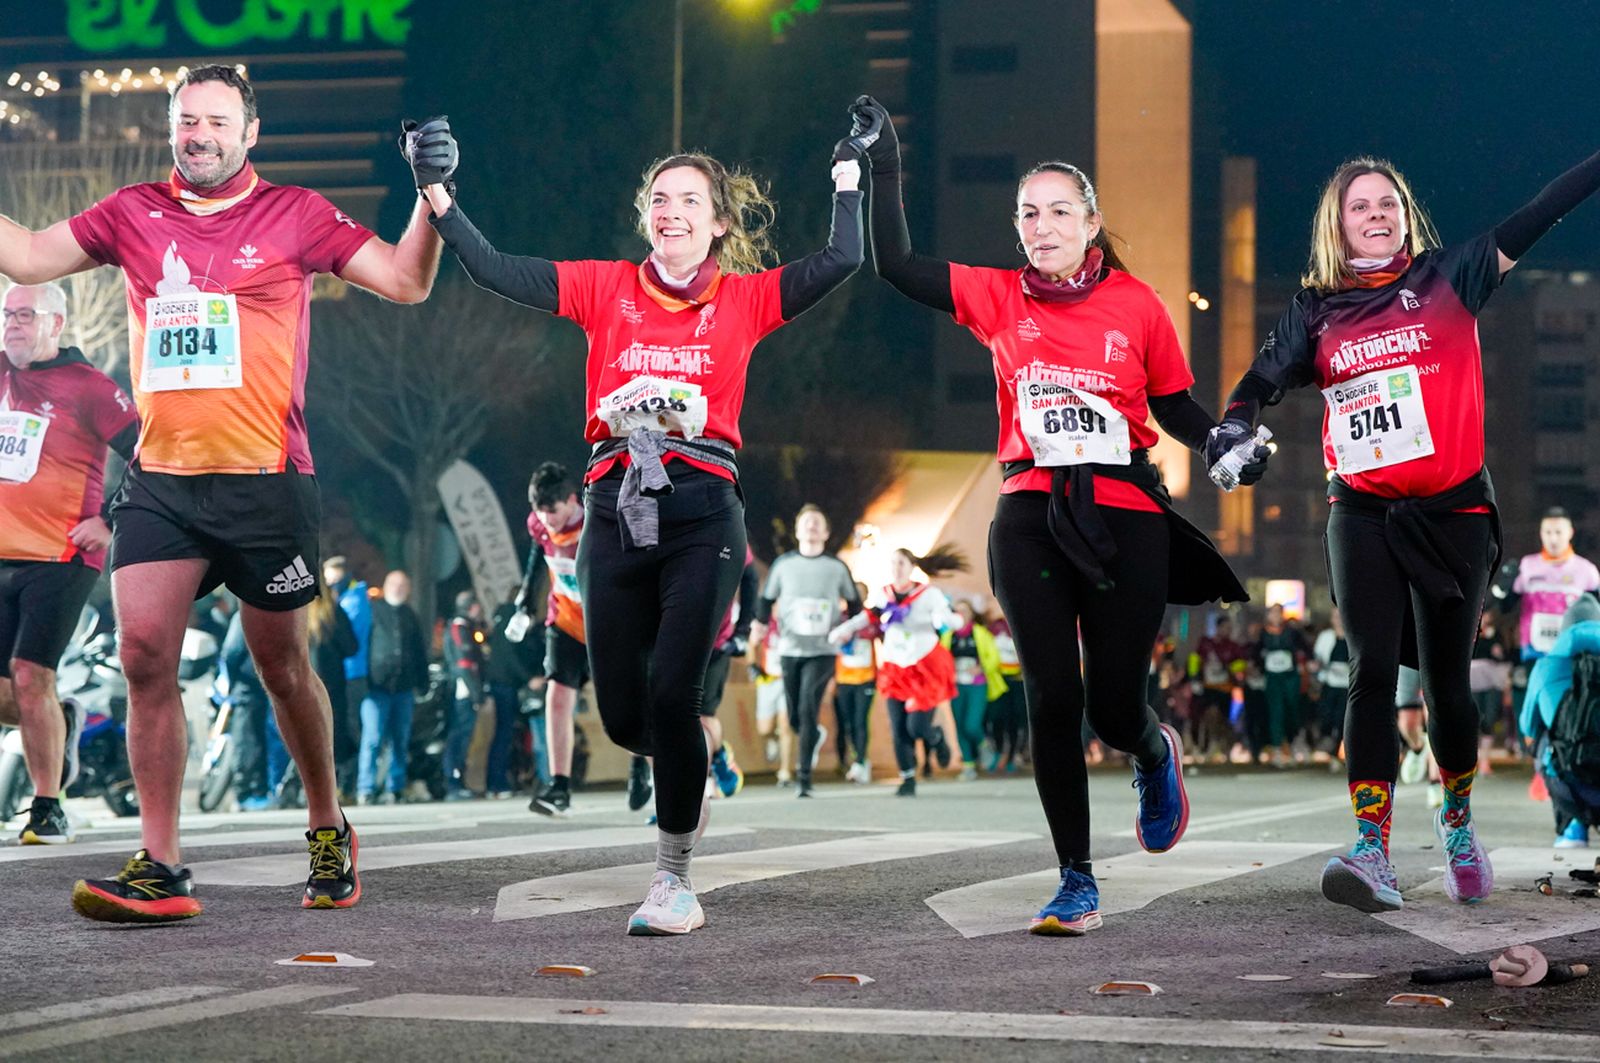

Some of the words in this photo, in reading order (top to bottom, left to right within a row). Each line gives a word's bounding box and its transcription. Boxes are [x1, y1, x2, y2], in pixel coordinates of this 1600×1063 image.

[187, 302, 199, 313] DE
[159, 326, 218, 357] 8134
[620, 348, 702, 376] ANTORCHA
[1334, 331, 1421, 375] ANTORCHA
[1345, 387, 1367, 402] NOCHE
[1367, 382, 1379, 393] DE
[1032, 399, 1052, 410] SAN
[1339, 403, 1354, 415] SAN
[1349, 402, 1403, 441] 5741
[266, 574, 315, 594] adidas
